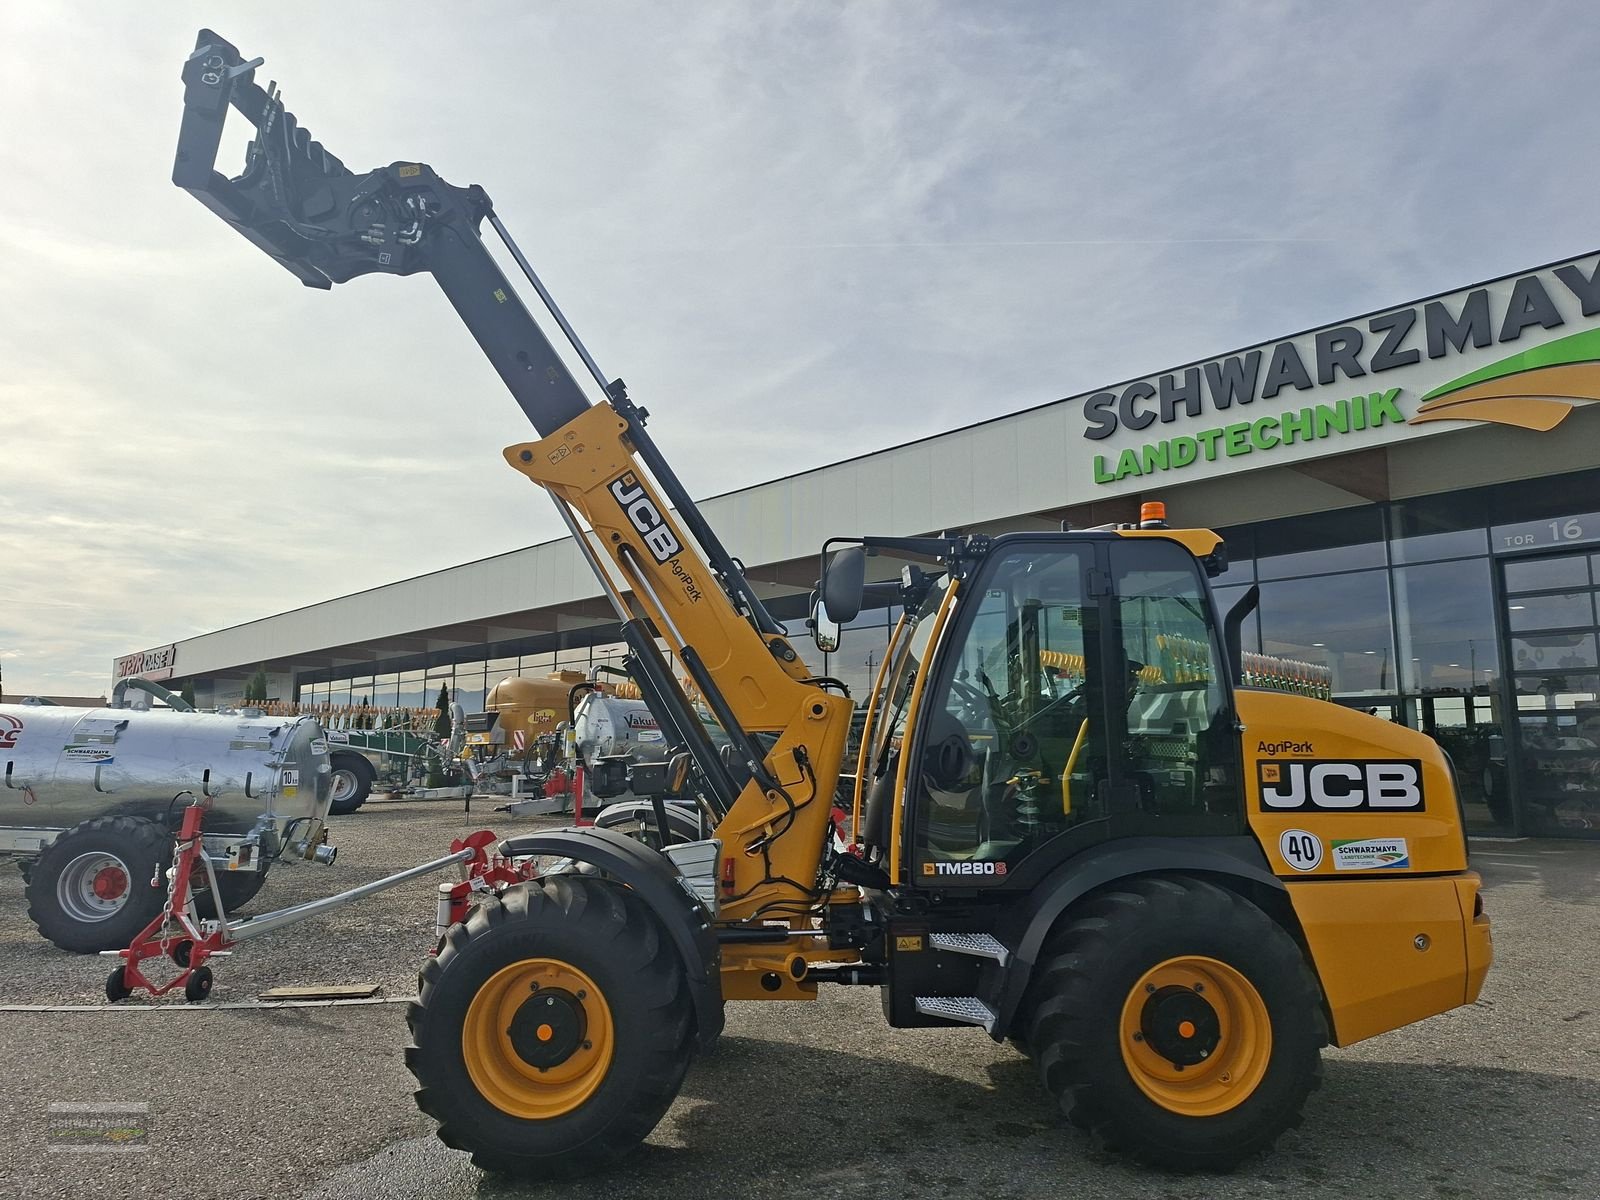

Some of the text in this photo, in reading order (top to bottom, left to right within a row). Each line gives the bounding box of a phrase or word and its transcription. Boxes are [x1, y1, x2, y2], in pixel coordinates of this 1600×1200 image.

[1094, 388, 1406, 484] LANDTECHNIK
[612, 480, 679, 561] JCB
[1504, 518, 1582, 546] TOR 16
[669, 559, 702, 602] AgriPark
[117, 652, 144, 678] STEYR
[1257, 741, 1313, 756] AgriPark
[284, 771, 292, 784] 10
[1263, 763, 1421, 808] JCB
[1288, 835, 1315, 863] 40
[1338, 845, 1397, 854] SCHWARZMAYR
